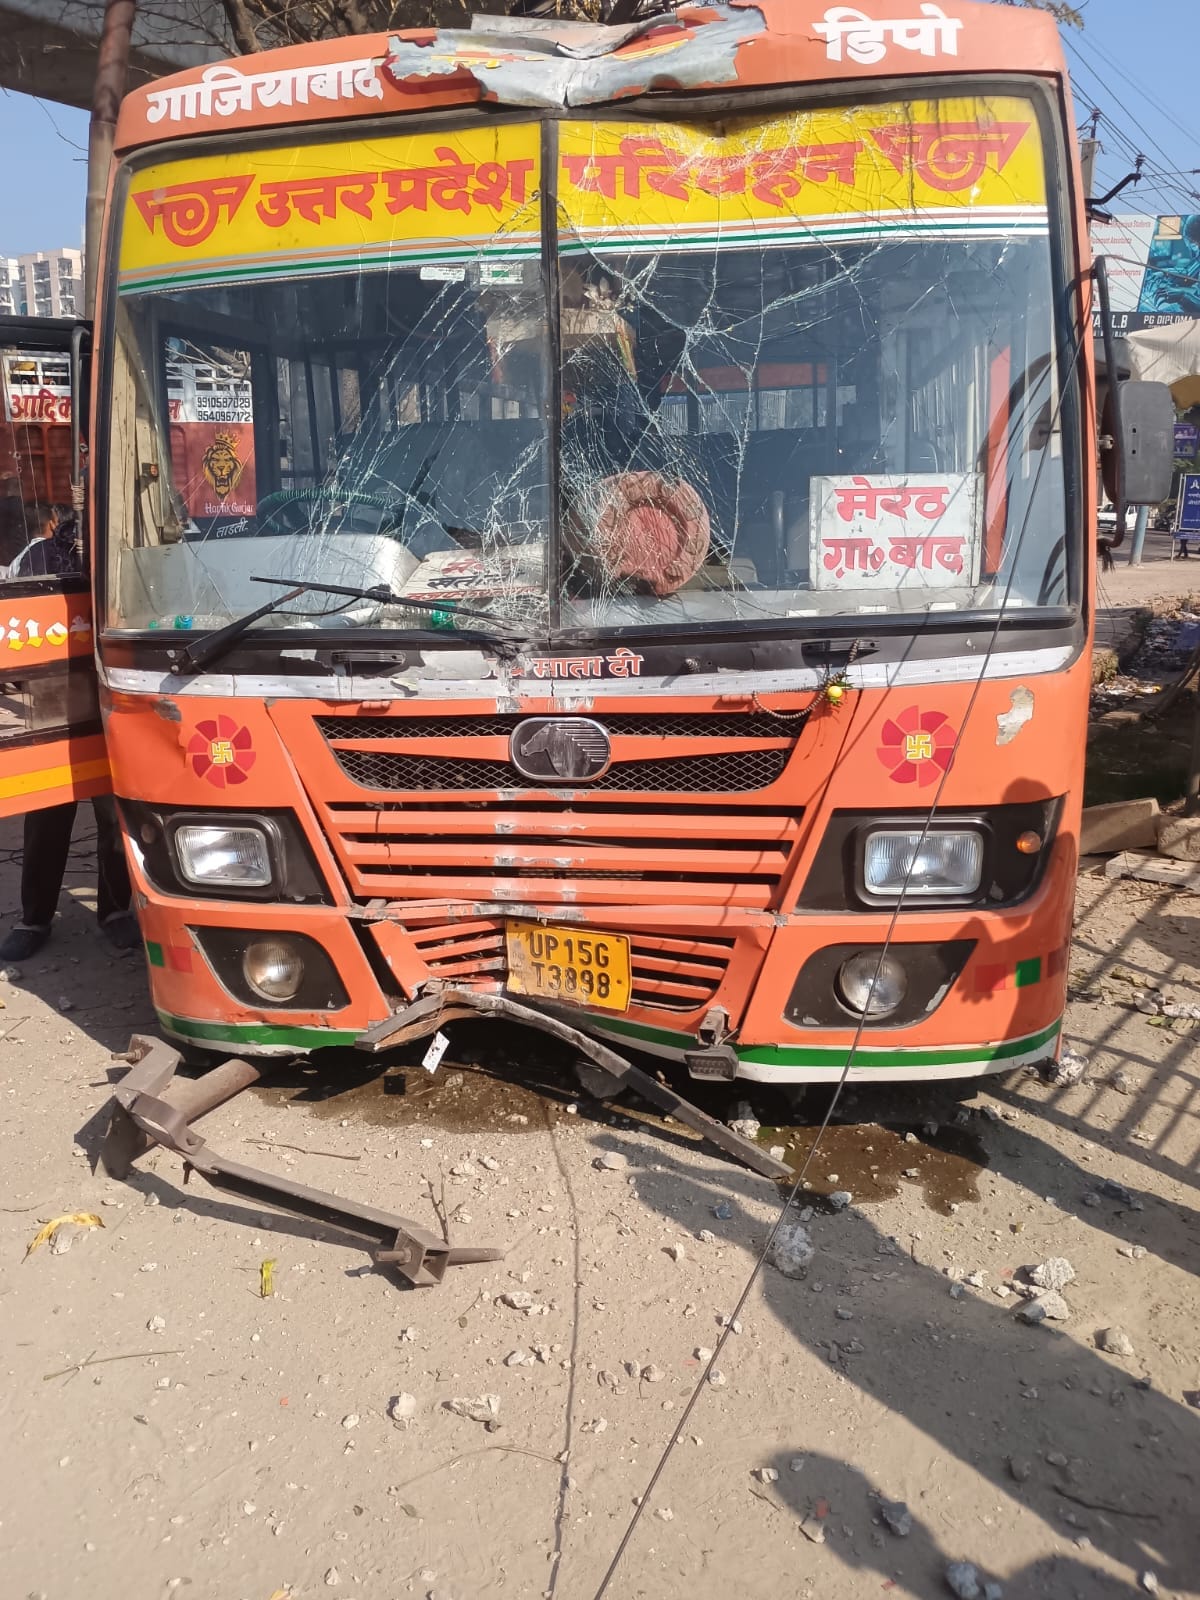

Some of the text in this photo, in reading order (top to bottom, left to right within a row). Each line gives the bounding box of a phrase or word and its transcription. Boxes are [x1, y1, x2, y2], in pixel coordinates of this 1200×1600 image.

[812, 5, 963, 65] डिपो
[146, 57, 384, 124] गाजियाबाद
[379, 146, 535, 217] प्रदेश
[1143, 315, 1155, 325] PG
[833, 476, 950, 522] मेरठ
[532, 656, 603, 679] माता
[608, 647, 645, 677] दी
[531, 961, 611, 999] T3898
